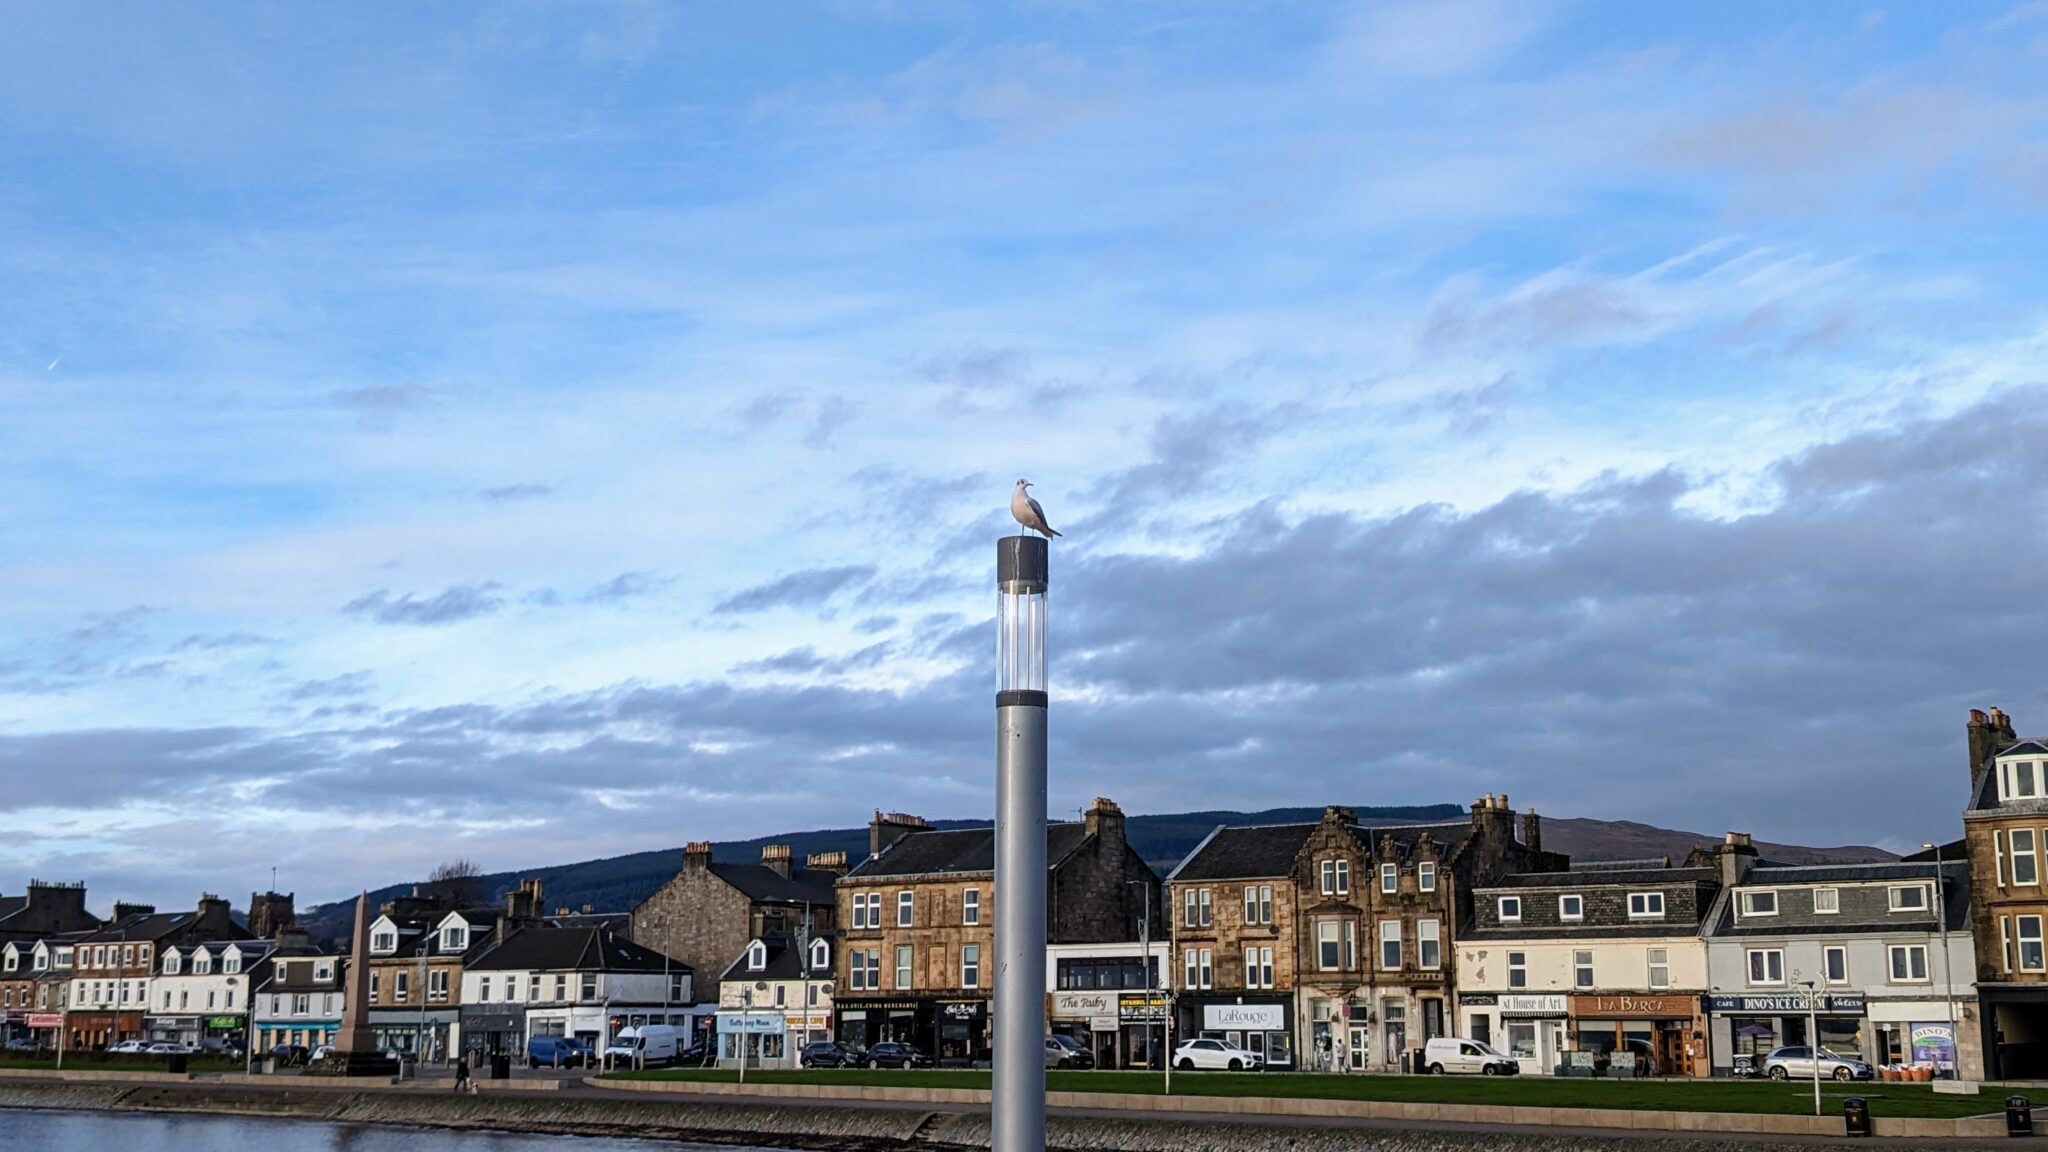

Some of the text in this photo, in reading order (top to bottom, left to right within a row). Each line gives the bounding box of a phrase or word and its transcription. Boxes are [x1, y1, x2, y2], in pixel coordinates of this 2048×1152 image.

[1060, 996, 1107, 1011] The Ruby
[1513, 997, 1536, 1009] House
[1538, 997, 1546, 1009] of
[1548, 997, 1561, 1009] Art
[1744, 999, 1775, 1009] DINO'S
[1775, 999, 1791, 1009] ICE
[1218, 1008, 1267, 1024] LaRouge
[1914, 1028, 1952, 1038] DINO'S
